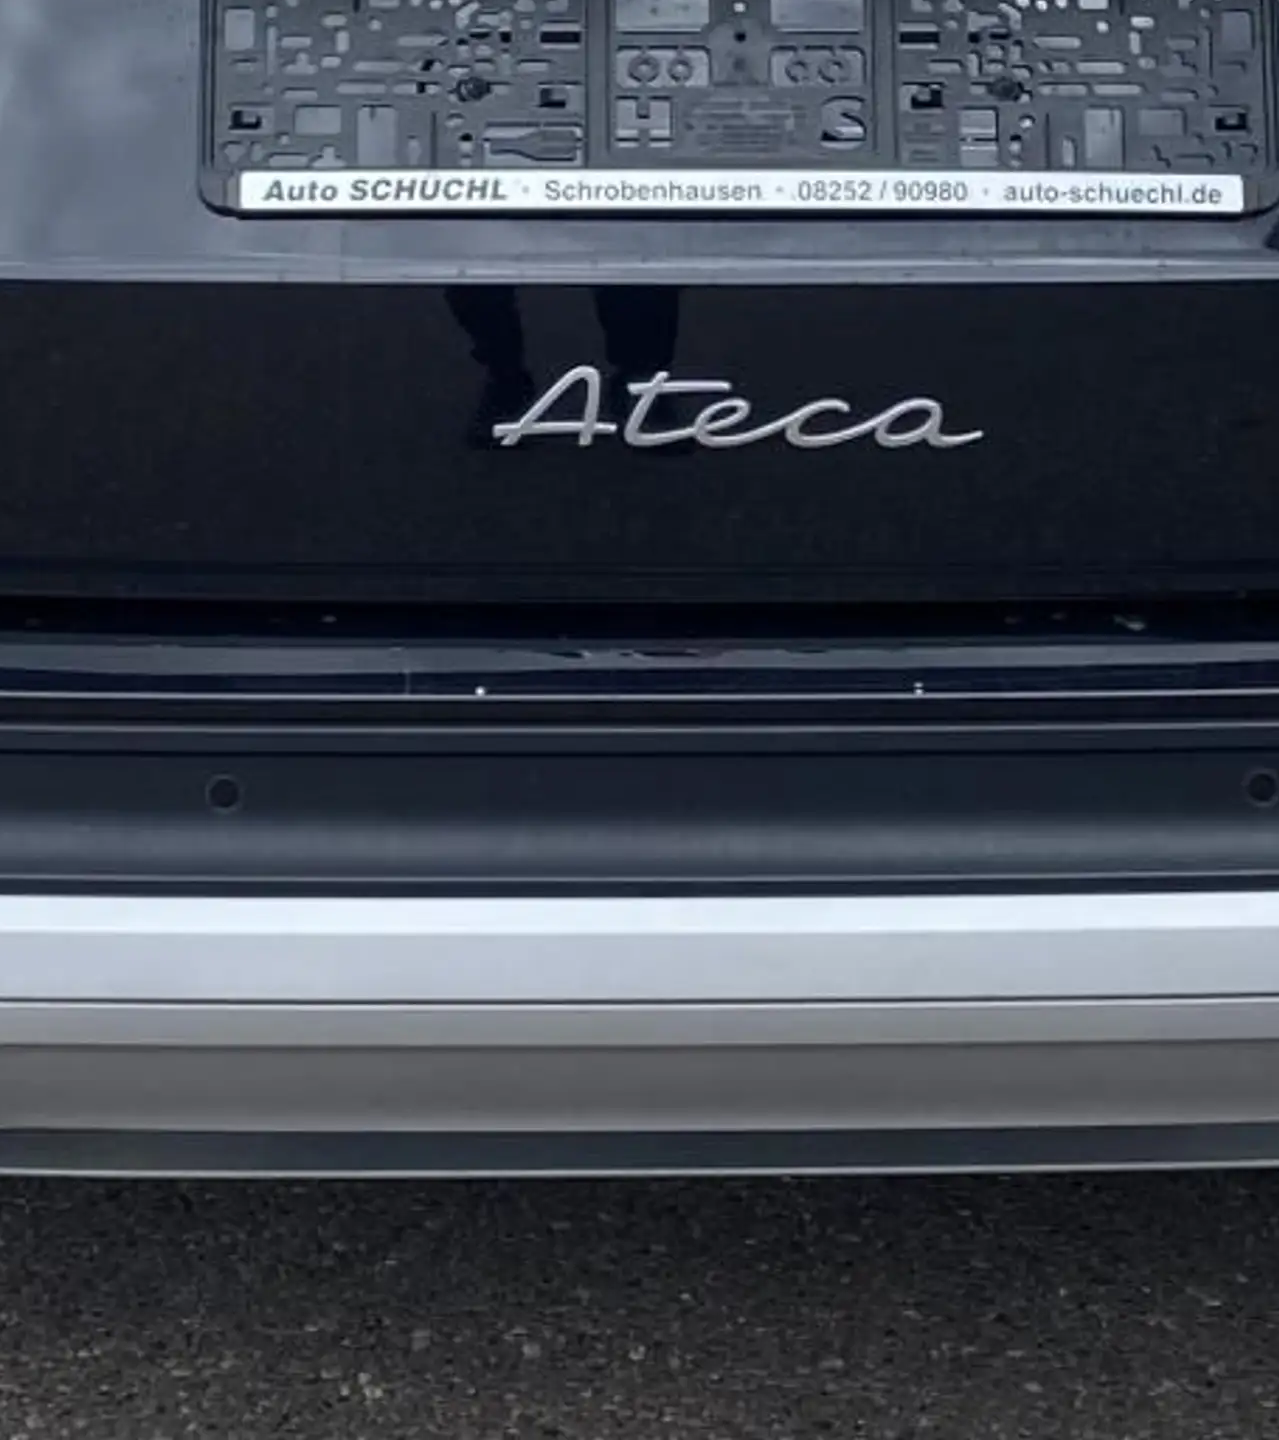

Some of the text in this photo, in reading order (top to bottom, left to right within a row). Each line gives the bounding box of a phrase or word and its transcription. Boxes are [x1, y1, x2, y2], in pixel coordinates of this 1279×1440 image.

[262, 179, 339, 202] Auto
[544, 179, 762, 202] Schrobenhausen
[1003, 182, 1223, 205] auto-schuechl.de
[492, 364, 984, 448] Ateca
